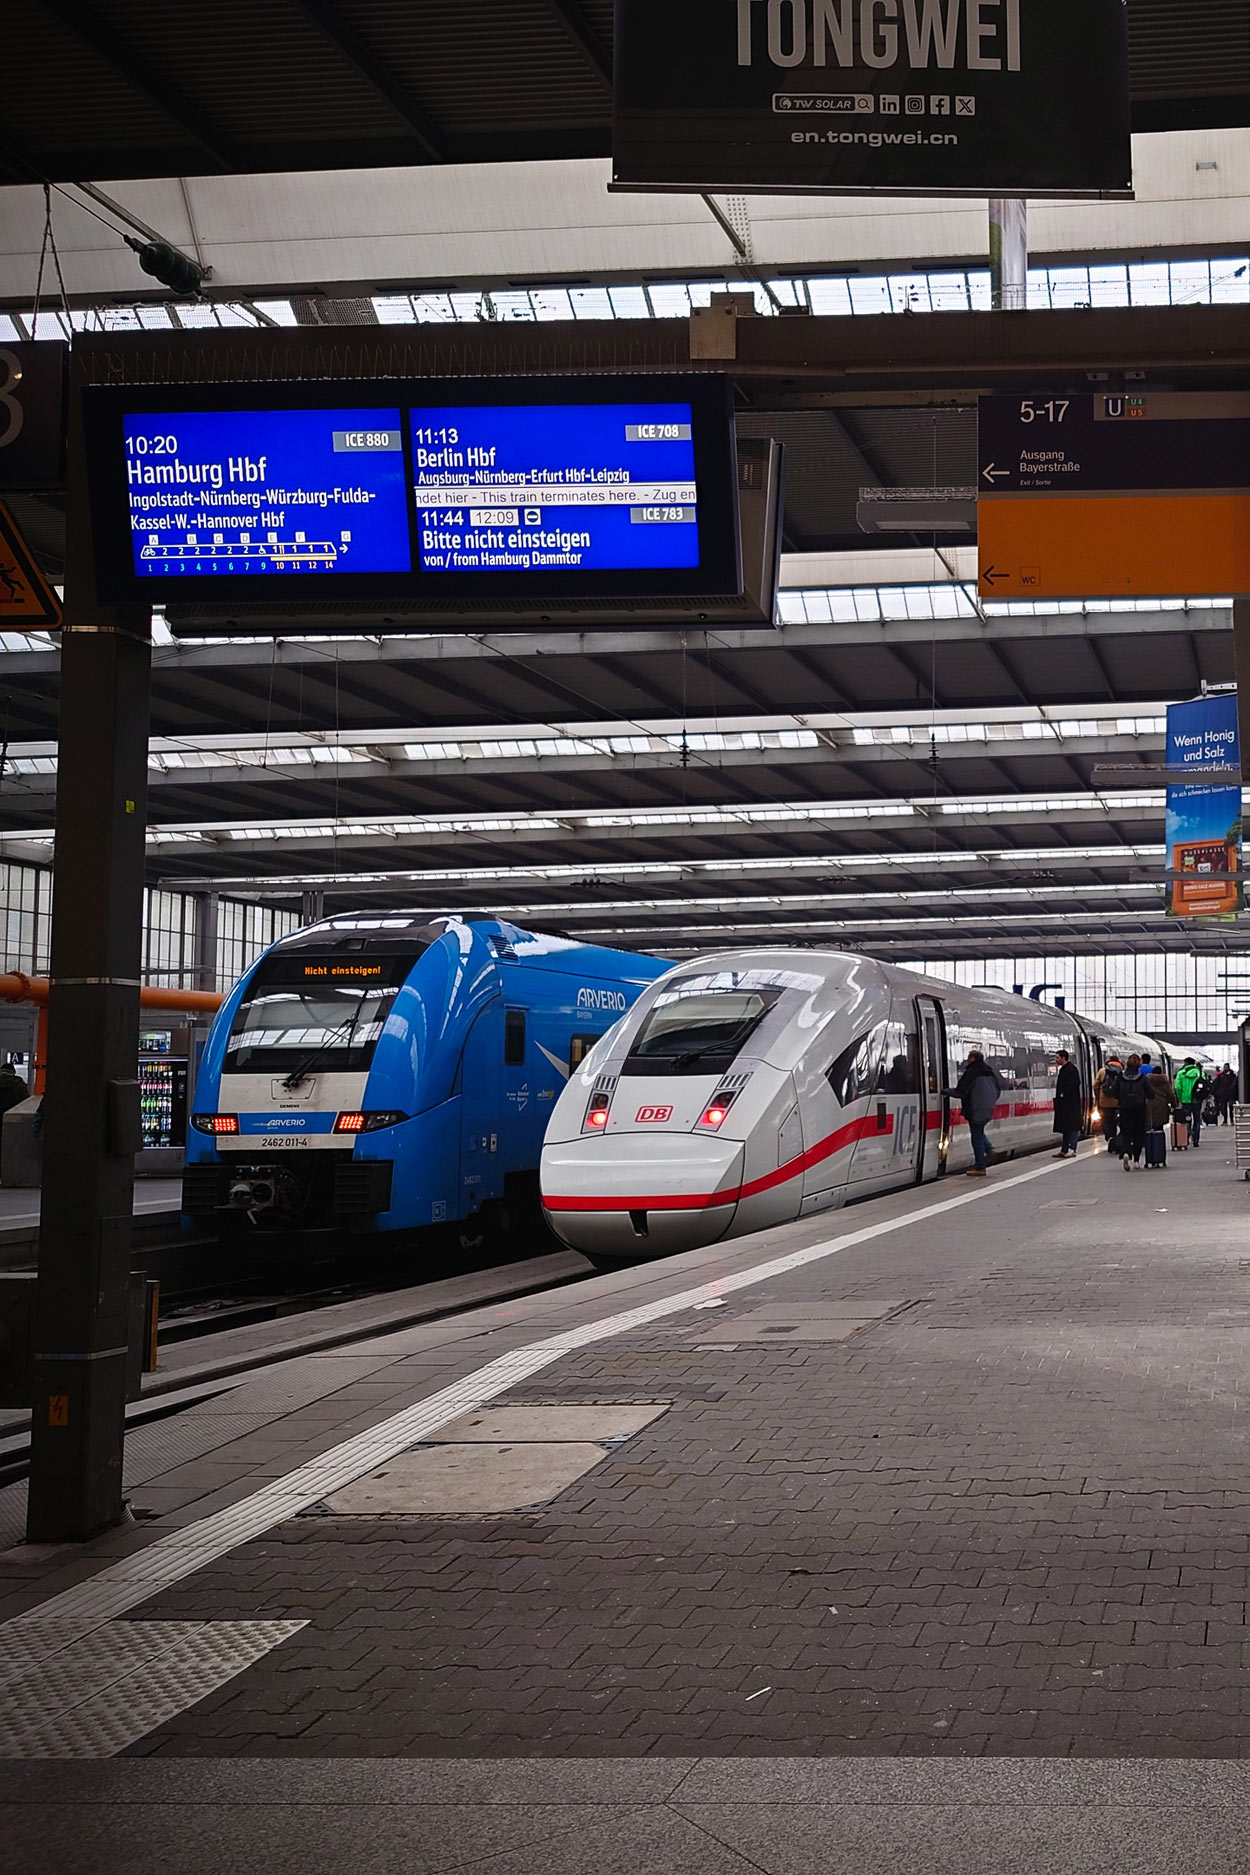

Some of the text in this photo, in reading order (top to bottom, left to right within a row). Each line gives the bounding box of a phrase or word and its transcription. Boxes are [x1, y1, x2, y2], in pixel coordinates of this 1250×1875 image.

[736, 0, 1021, 71] TONGWEI
[815, 99, 851, 109] SOLAR
[791, 130, 958, 148] en.tongwei.cn
[1020, 400, 1069, 423] 5-17
[1109, 399, 1121, 416] U
[416, 428, 459, 444] 11:13
[638, 424, 679, 438] ICE 708
[126, 436, 177, 454] 10:20
[345, 433, 389, 447] ICE 880
[417, 447, 496, 467] Berlin Hbf
[1020, 450, 1065, 461] Ausgang
[127, 456, 267, 488] Hamburg Hbf
[1020, 461, 1080, 473] Bayerstraße
[418, 468, 630, 487] Augsburg-Nürnberg-Erfurt Hbf-Leipzig
[129, 487, 376, 510] Ingolstadt-Nürnberg-Würzburg-Fulda-
[445, 492, 469, 503] hier
[482, 491, 507, 502] This
[510, 491, 538, 502] train
[540, 490, 606, 502] terminates
[608, 489, 640, 501] here.
[653, 489, 678, 503] Zug
[131, 511, 285, 530] Kassel-W.-Hannover Hbf
[422, 510, 514, 526] 11:44 12:09
[643, 507, 683, 521] ICE 783
[423, 528, 591, 551] Bitte nicht einsteigen
[276, 561, 285, 570] 10
[292, 561, 300, 569] 11
[308, 561, 317, 569] 12
[325, 560, 333, 569] 14
[424, 552, 582, 568] von from Hamburg Dammtor
[1022, 575, 1036, 584] WC
[1174, 729, 1234, 747] Wenn Honig
[1184, 745, 1225, 761] und Salz
[305, 966, 381, 976] Nicht einsteigen!
[577, 987, 626, 1011] ARVERIO
[640, 1107, 669, 1121] DB
[893, 1106, 917, 1155] ICE
[262, 1138, 307, 1147] 2462 011-4
